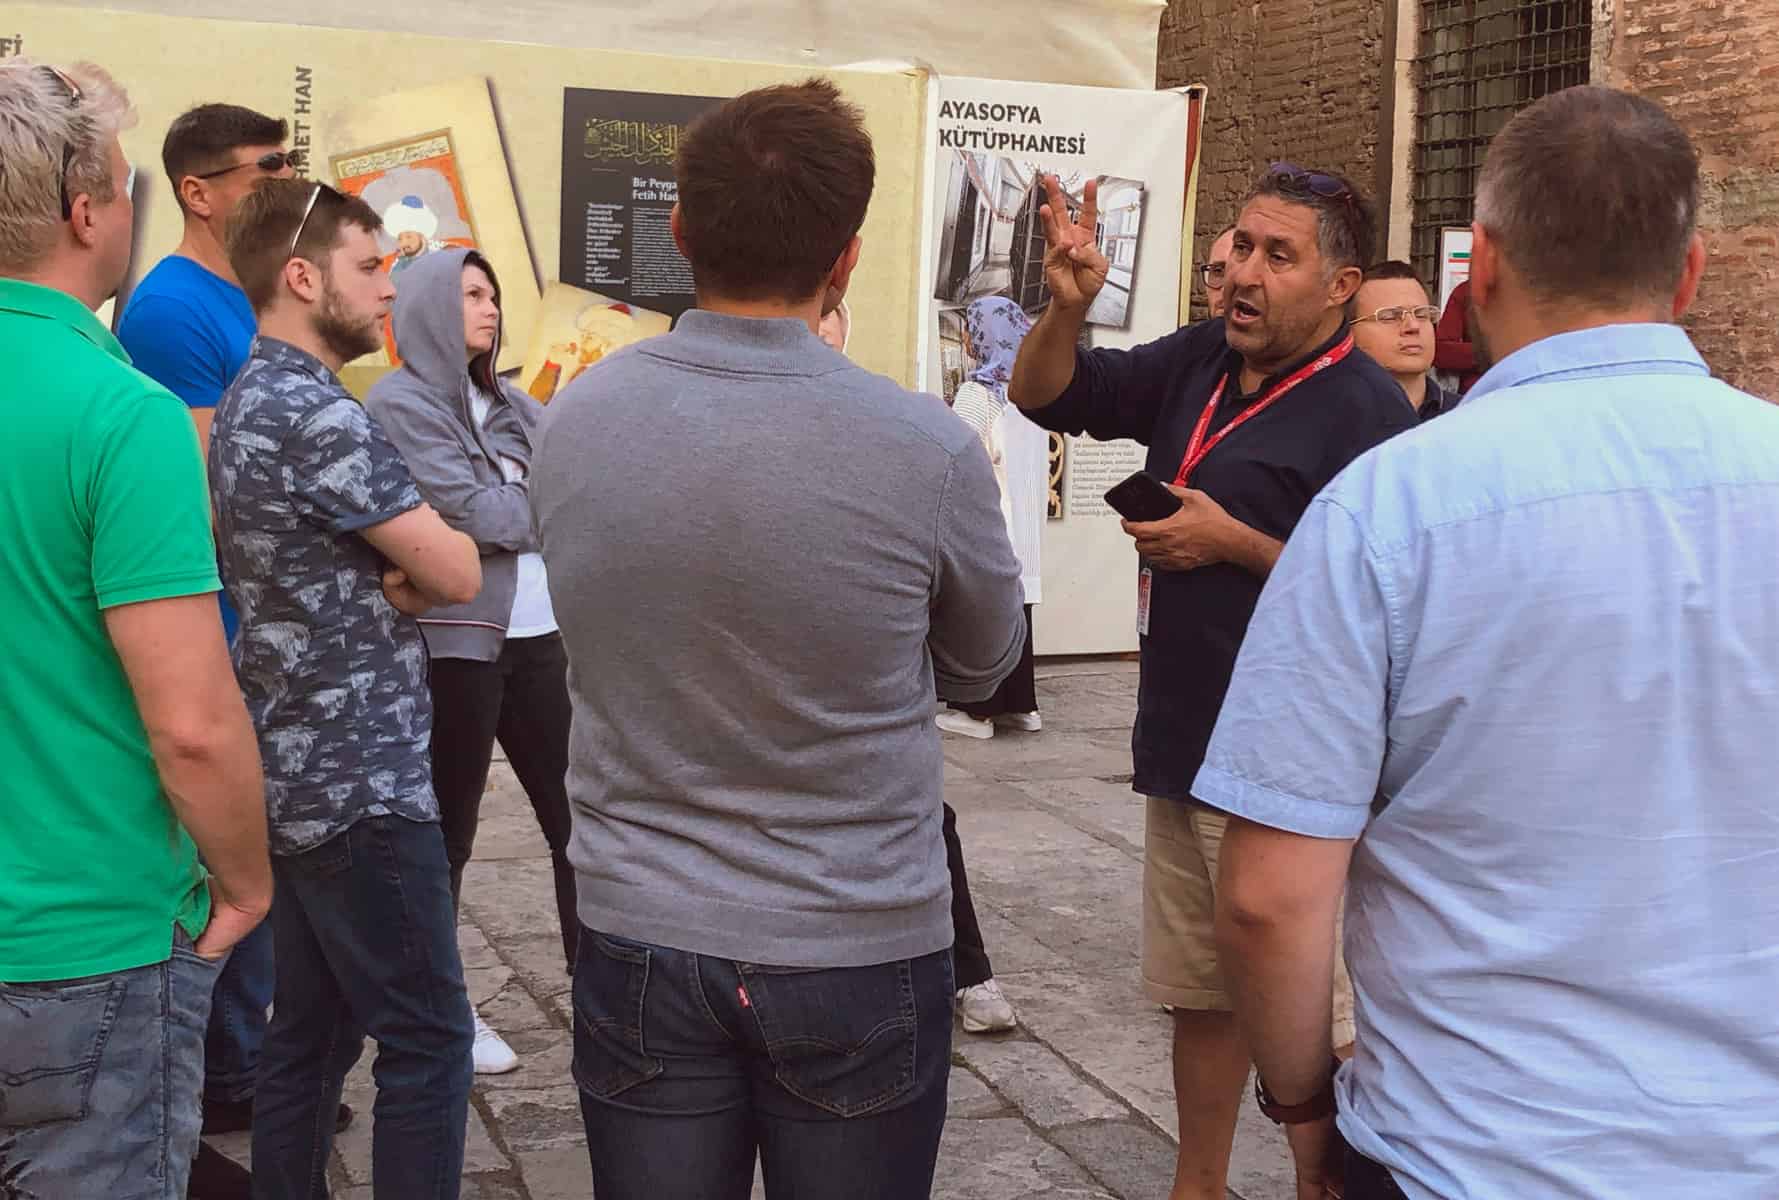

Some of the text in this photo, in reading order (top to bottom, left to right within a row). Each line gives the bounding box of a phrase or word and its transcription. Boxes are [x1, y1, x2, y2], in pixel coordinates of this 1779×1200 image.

[295, 66, 312, 114] HAN
[939, 100, 1042, 125] AYASOFYA
[939, 125, 1087, 155] KÜTÜPHANESİ
[632, 189, 656, 200] Fetih
[633, 177, 647, 188] Bir
